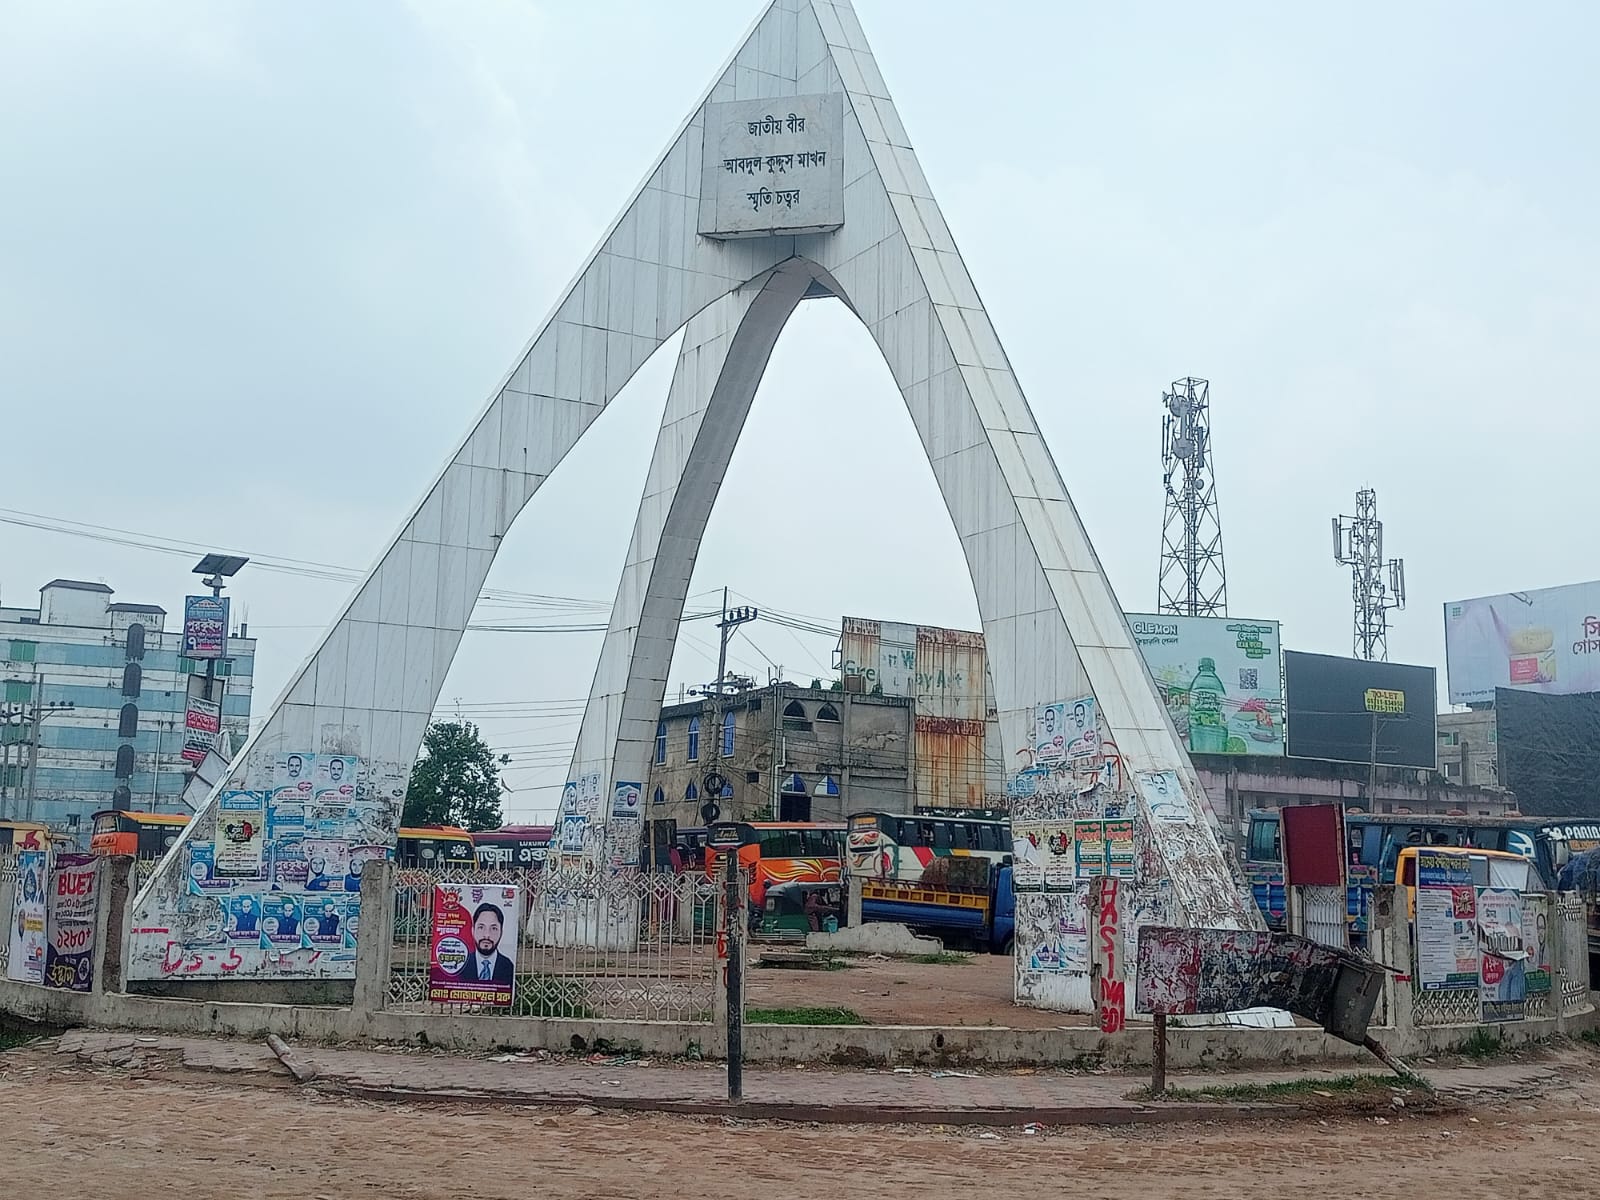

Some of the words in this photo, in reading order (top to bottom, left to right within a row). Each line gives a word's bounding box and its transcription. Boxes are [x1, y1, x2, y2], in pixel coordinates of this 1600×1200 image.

[748, 115, 782, 137] জাতীয়
[786, 113, 806, 134] বীর
[723, 156, 762, 175] আবদুল
[765, 154, 793, 175] কুদ্দুস
[797, 151, 826, 168] মাখন
[747, 187, 772, 212] স্মৃতি
[775, 189, 801, 209] চত্বর
[1133, 621, 1178, 635] CLEMON
[57, 871, 95, 896] BUET
[431, 988, 449, 999] মোঃ
